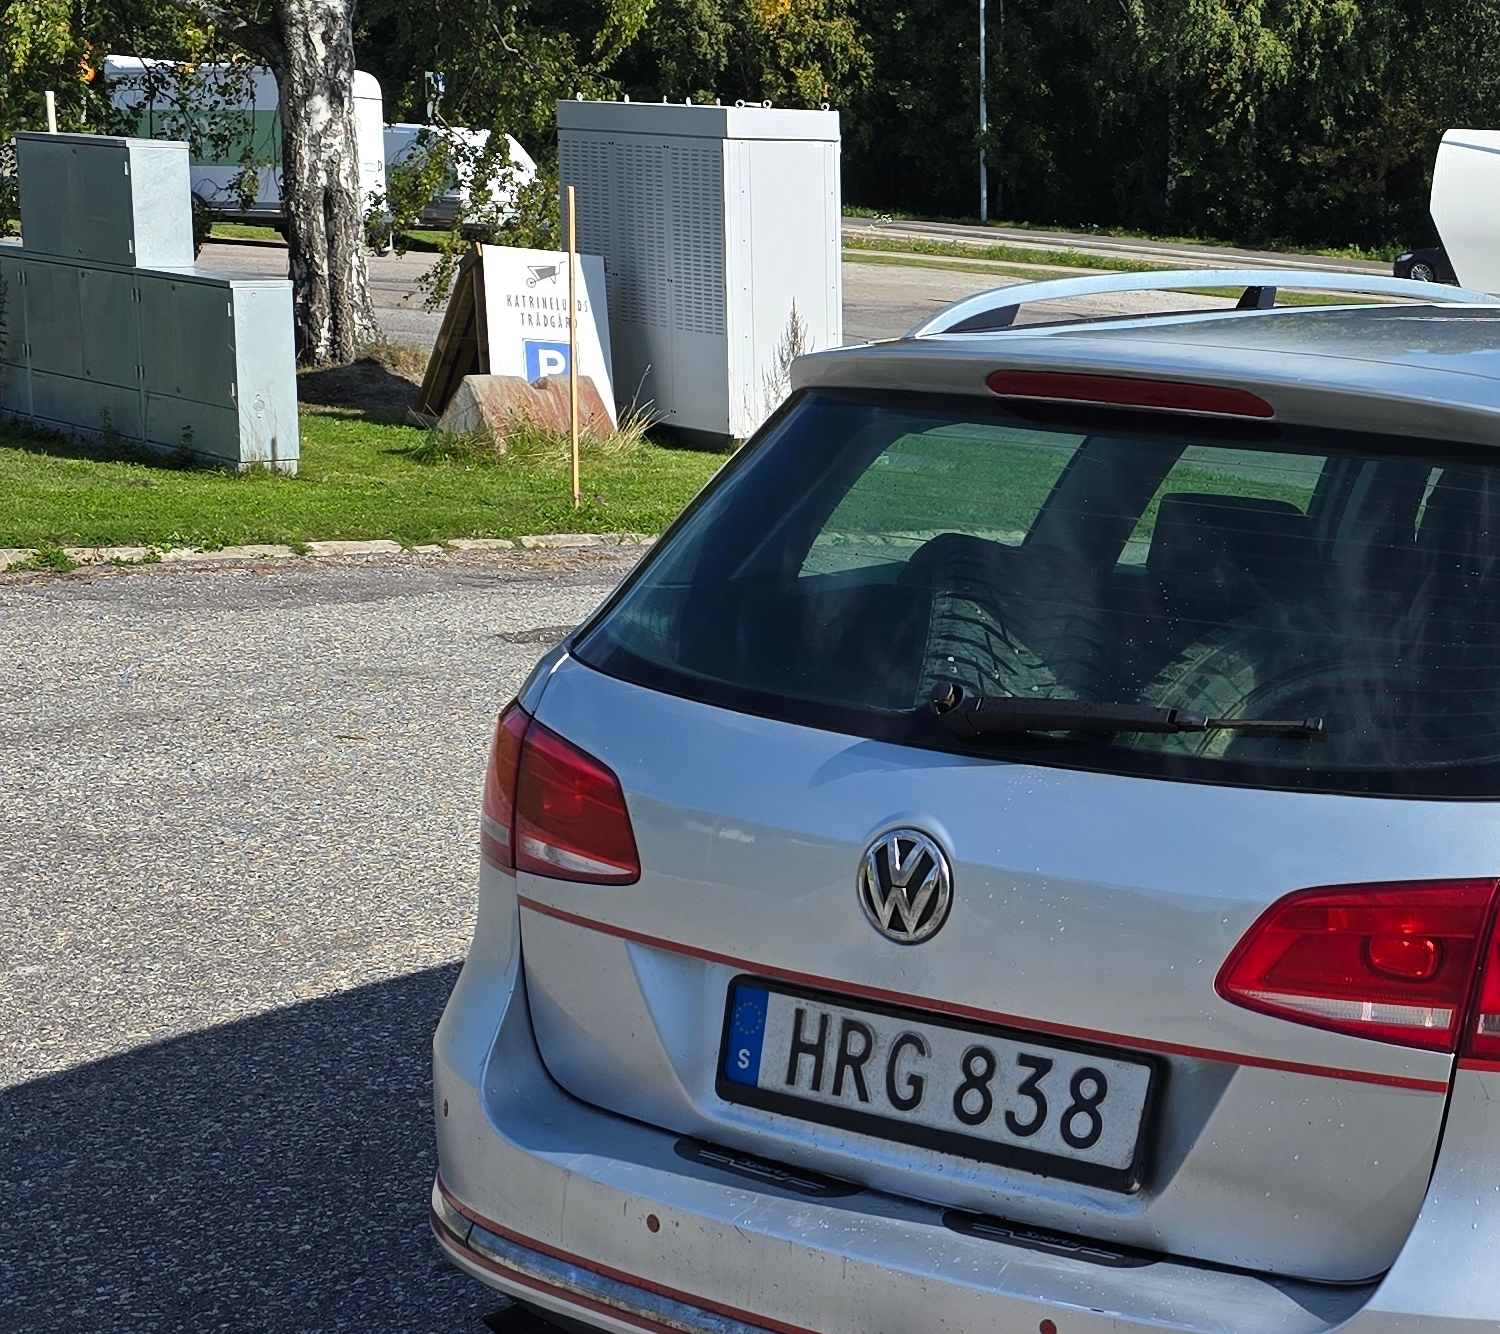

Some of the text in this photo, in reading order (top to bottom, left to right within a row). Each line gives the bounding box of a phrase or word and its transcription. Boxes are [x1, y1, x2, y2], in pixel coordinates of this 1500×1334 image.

[506, 293, 588, 313] KATRINELUDS
[538, 348, 566, 378] P
[736, 1048, 751, 1070] S
[786, 1007, 1109, 1150] HRG 838
